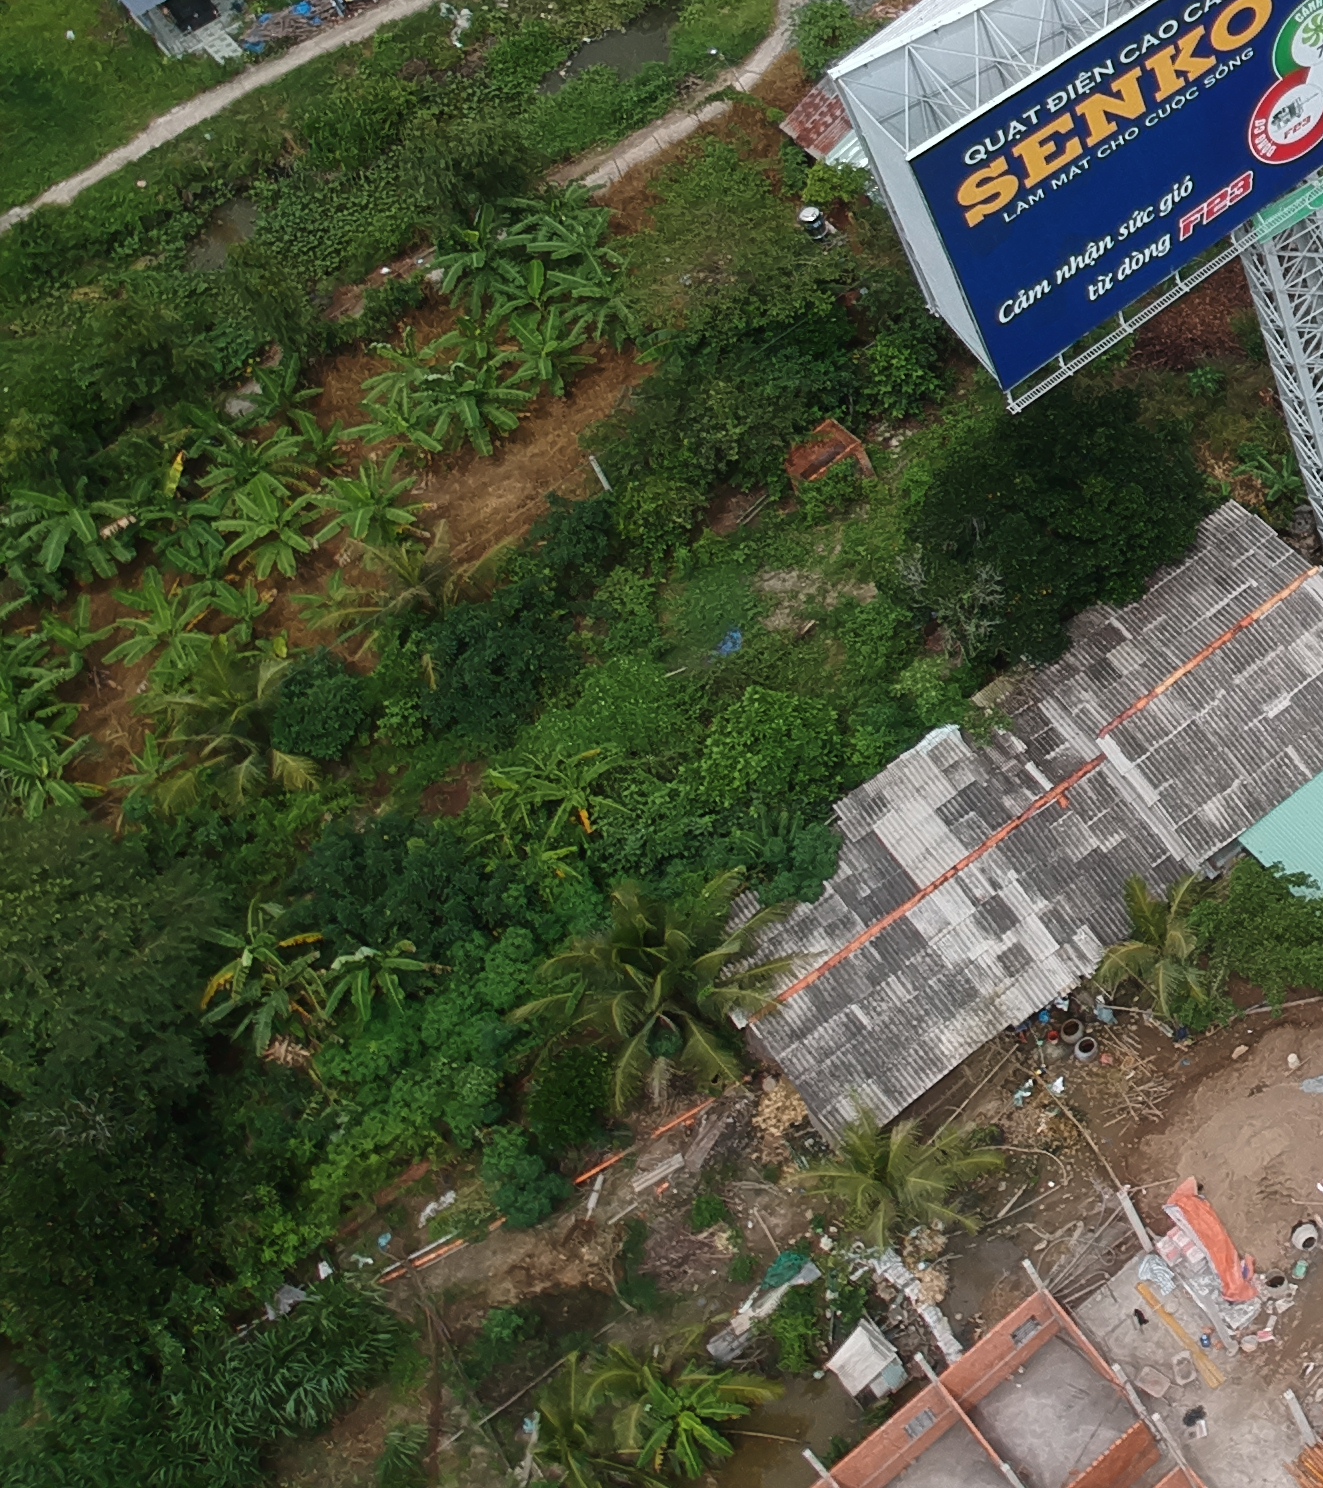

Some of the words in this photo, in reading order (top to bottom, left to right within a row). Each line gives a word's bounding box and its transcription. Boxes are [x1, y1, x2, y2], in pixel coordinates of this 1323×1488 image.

[964, 105, 1042, 165] QUẠT
[1046, 59, 1116, 113] ĐIỆN
[1119, 19, 1179, 64] CAO
[1097, 127, 1139, 158] CHO
[1145, 86, 1199, 127] CUỘC
[998, 279, 1052, 324] Cảm
[1055, 235, 1115, 285] nhận
[1118, 206, 1155, 240] sức
[1159, 175, 1193, 217] gió
[1087, 272, 1114, 301] từ
[1117, 233, 1171, 281] dòng
